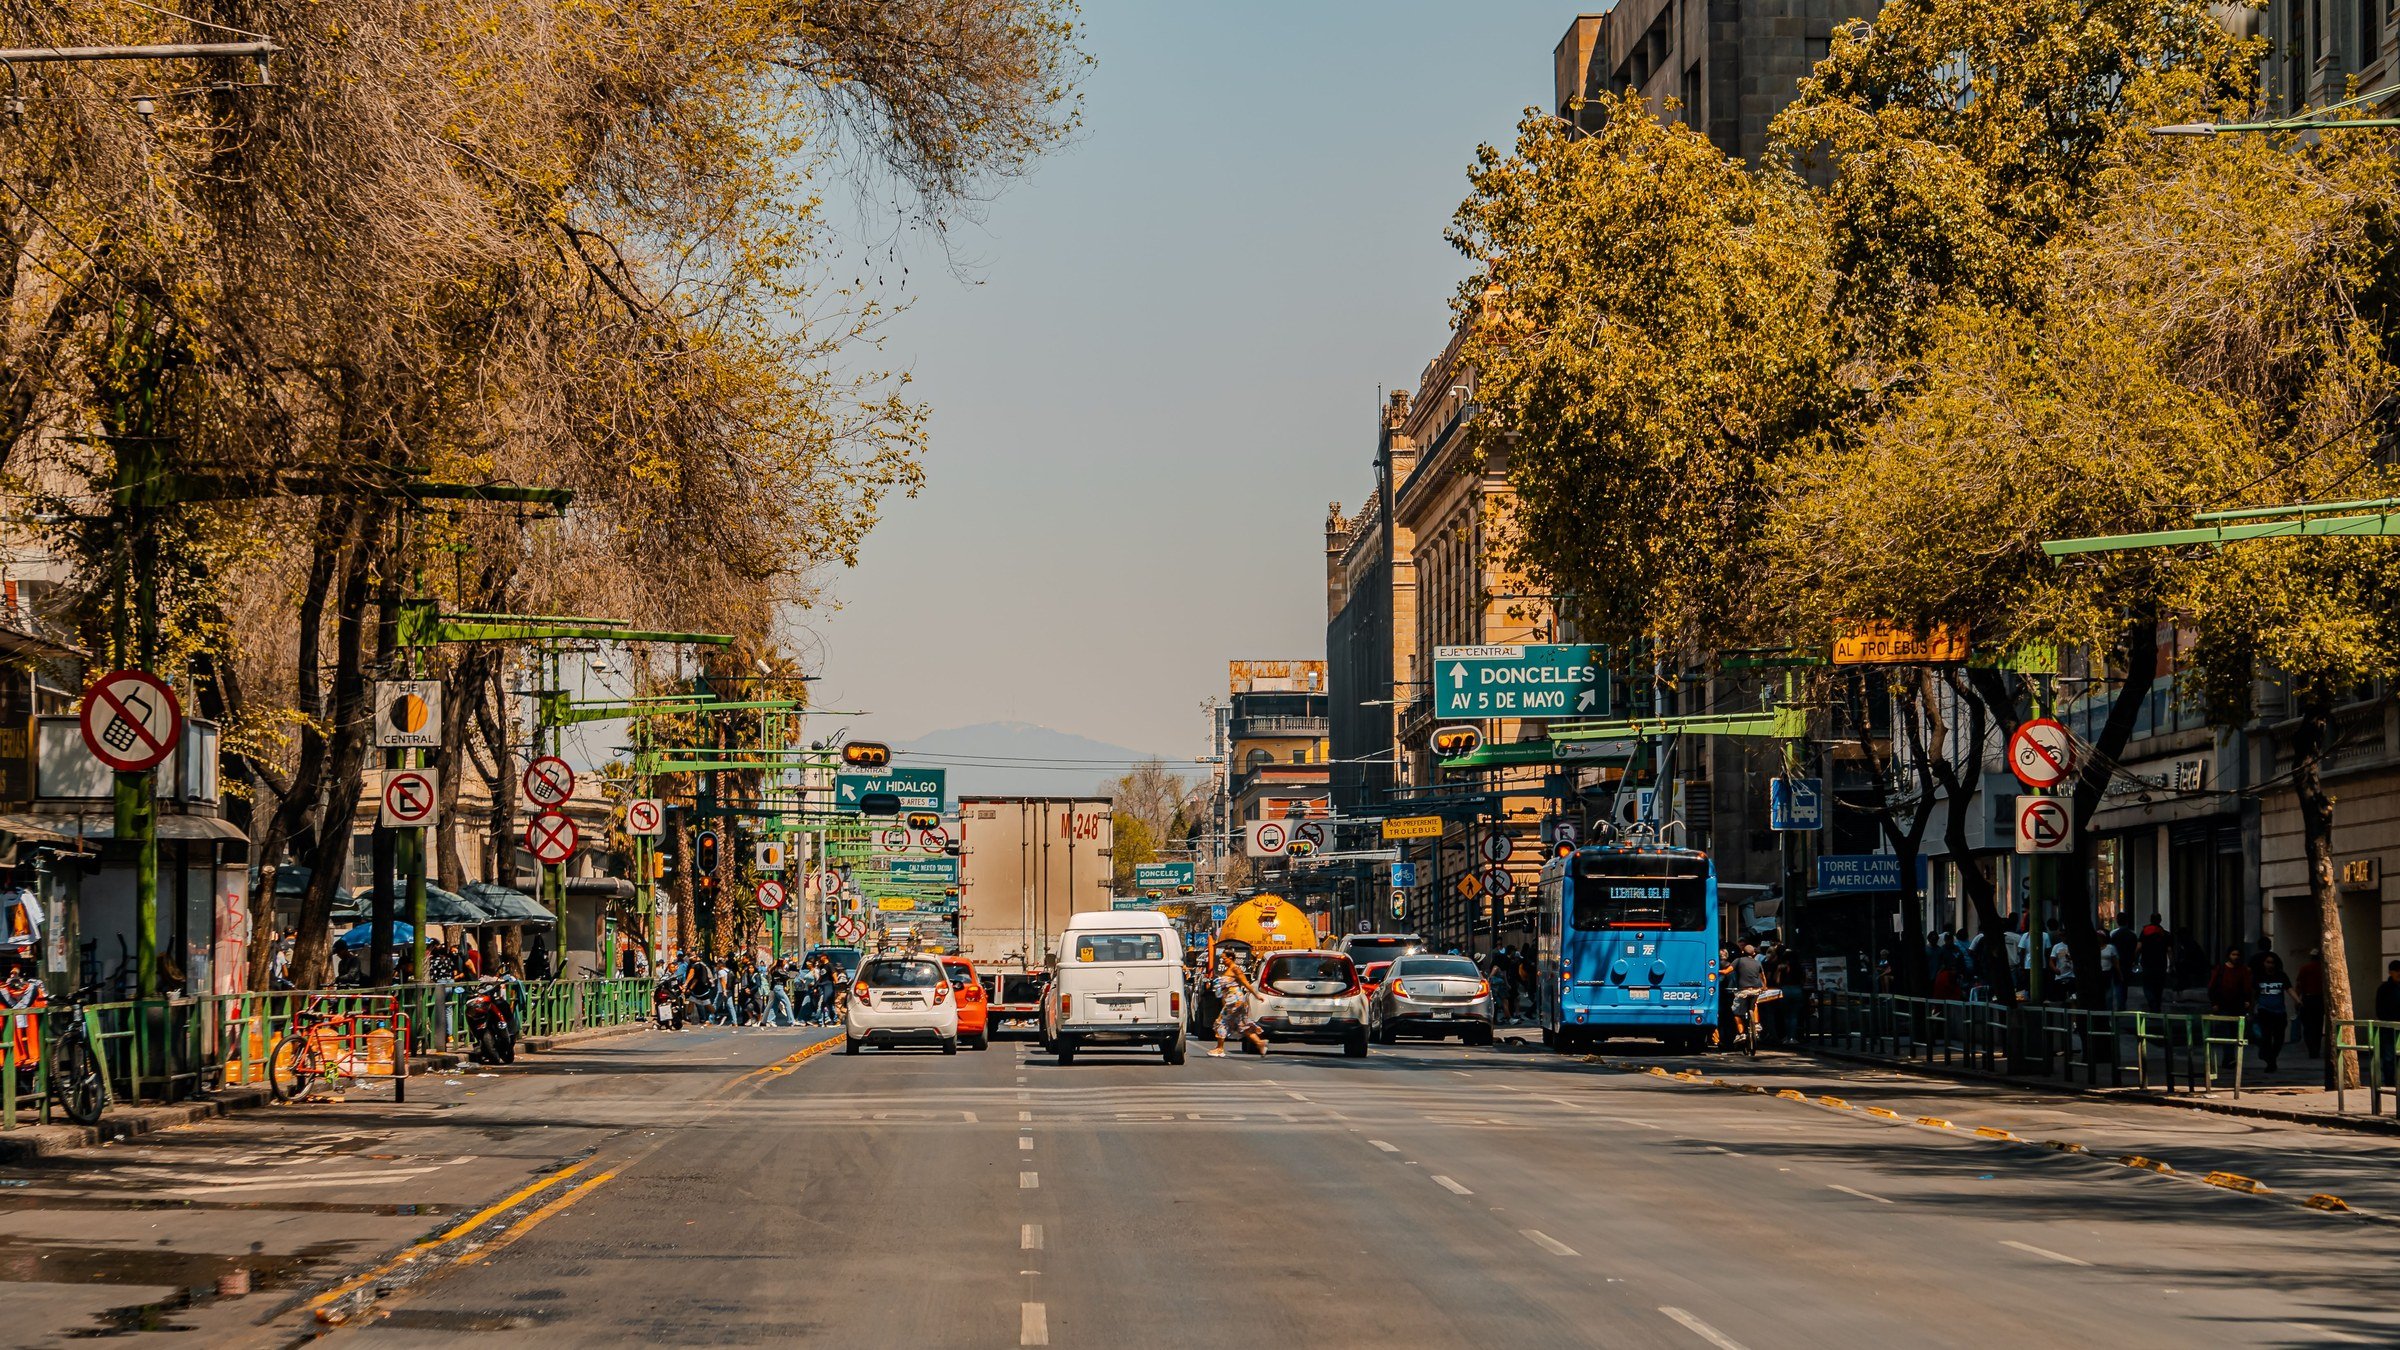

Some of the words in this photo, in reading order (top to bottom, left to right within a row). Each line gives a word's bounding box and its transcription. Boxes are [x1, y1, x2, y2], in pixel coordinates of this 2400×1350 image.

[1440, 648, 1461, 657] EJE
[1466, 647, 1517, 657] CENTRAL
[1837, 643, 1854, 657] AL
[1860, 641, 1928, 656] TROLEBUS
[1480, 666, 1596, 685] DONCELES
[399, 683, 418, 693] EJE
[1451, 692, 1472, 710] AV
[1478, 692, 1489, 710] 5
[1496, 692, 1516, 709] DE
[1523, 690, 1565, 709] MAYO
[383, 735, 434, 744] CENTRAL
[864, 781, 881, 791] AV
[886, 781, 937, 793] HIDALGO
[907, 798, 926, 806] ARTES
[1061, 813, 1098, 840] M-248
[1403, 818, 1438, 827] PREFERENTE
[1389, 826, 1437, 835] TROLEBUS
[1823, 860, 1859, 872] TORRE
[1140, 870, 1179, 878] DONCELES
[1829, 874, 1897, 886] AMERICANA
[1663, 991, 1699, 1001] 22024
